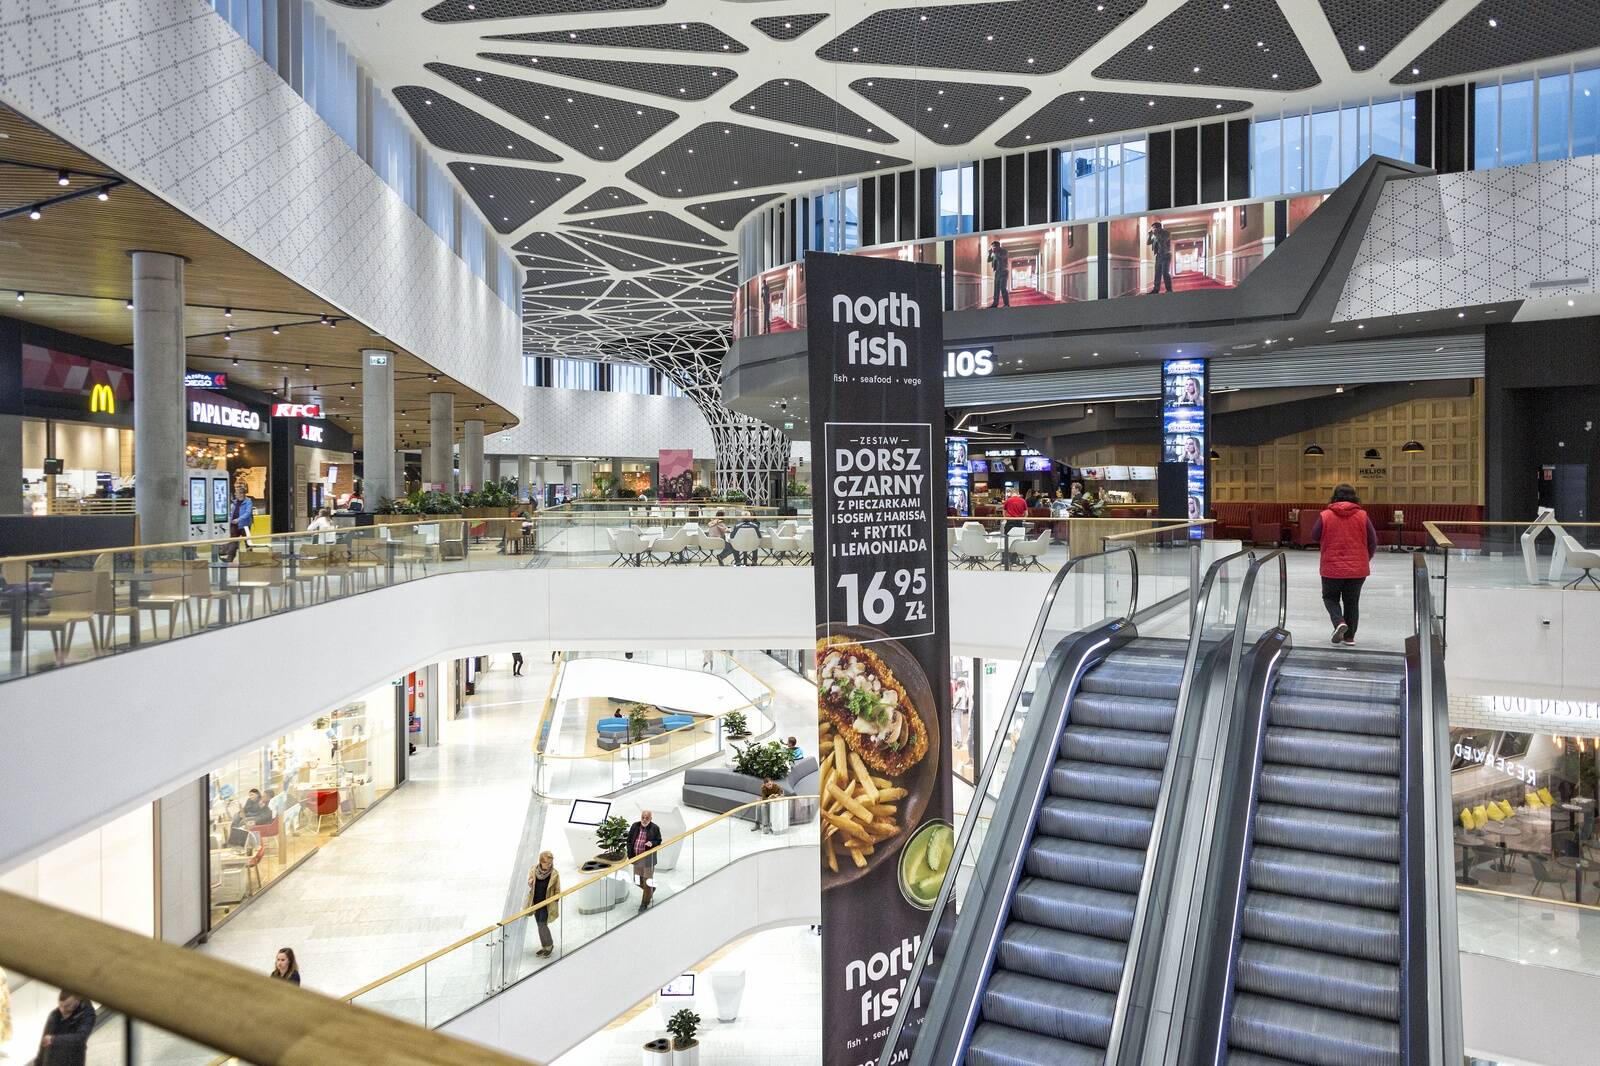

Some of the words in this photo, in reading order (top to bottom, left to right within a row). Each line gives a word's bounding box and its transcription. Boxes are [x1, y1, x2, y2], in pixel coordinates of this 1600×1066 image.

[832, 291, 921, 328] north
[848, 330, 908, 367] fish
[943, 349, 994, 378] IOS
[833, 373, 848, 382] fish
[860, 374, 892, 384] seafood
[903, 377, 922, 386] vege
[192, 401, 222, 426] PAPA
[220, 405, 260, 431] DIEGO
[275, 403, 316, 417] KFC
[860, 436, 899, 445] ZESTAW
[835, 447, 922, 472] DORSZ
[833, 474, 925, 498] CZARNY
[837, 500, 845, 511] Z
[848, 497, 921, 510] PIECZARKAMI
[831, 513, 836, 525] I
[837, 512, 874, 524] SOSEM
[876, 511, 883, 522] Z
[883, 509, 927, 522] HARISSĄ
[851, 528, 860, 539] +
[864, 524, 912, 540] FRYTKI
[832, 543, 837, 557] I
[841, 538, 928, 557] LEMONIADA
[836, 570, 896, 627] 16
[894, 567, 927, 596] 95
[904, 600, 927, 622] ZŁ
[846, 935, 934, 991] north
[847, 1037, 861, 1050] fish
